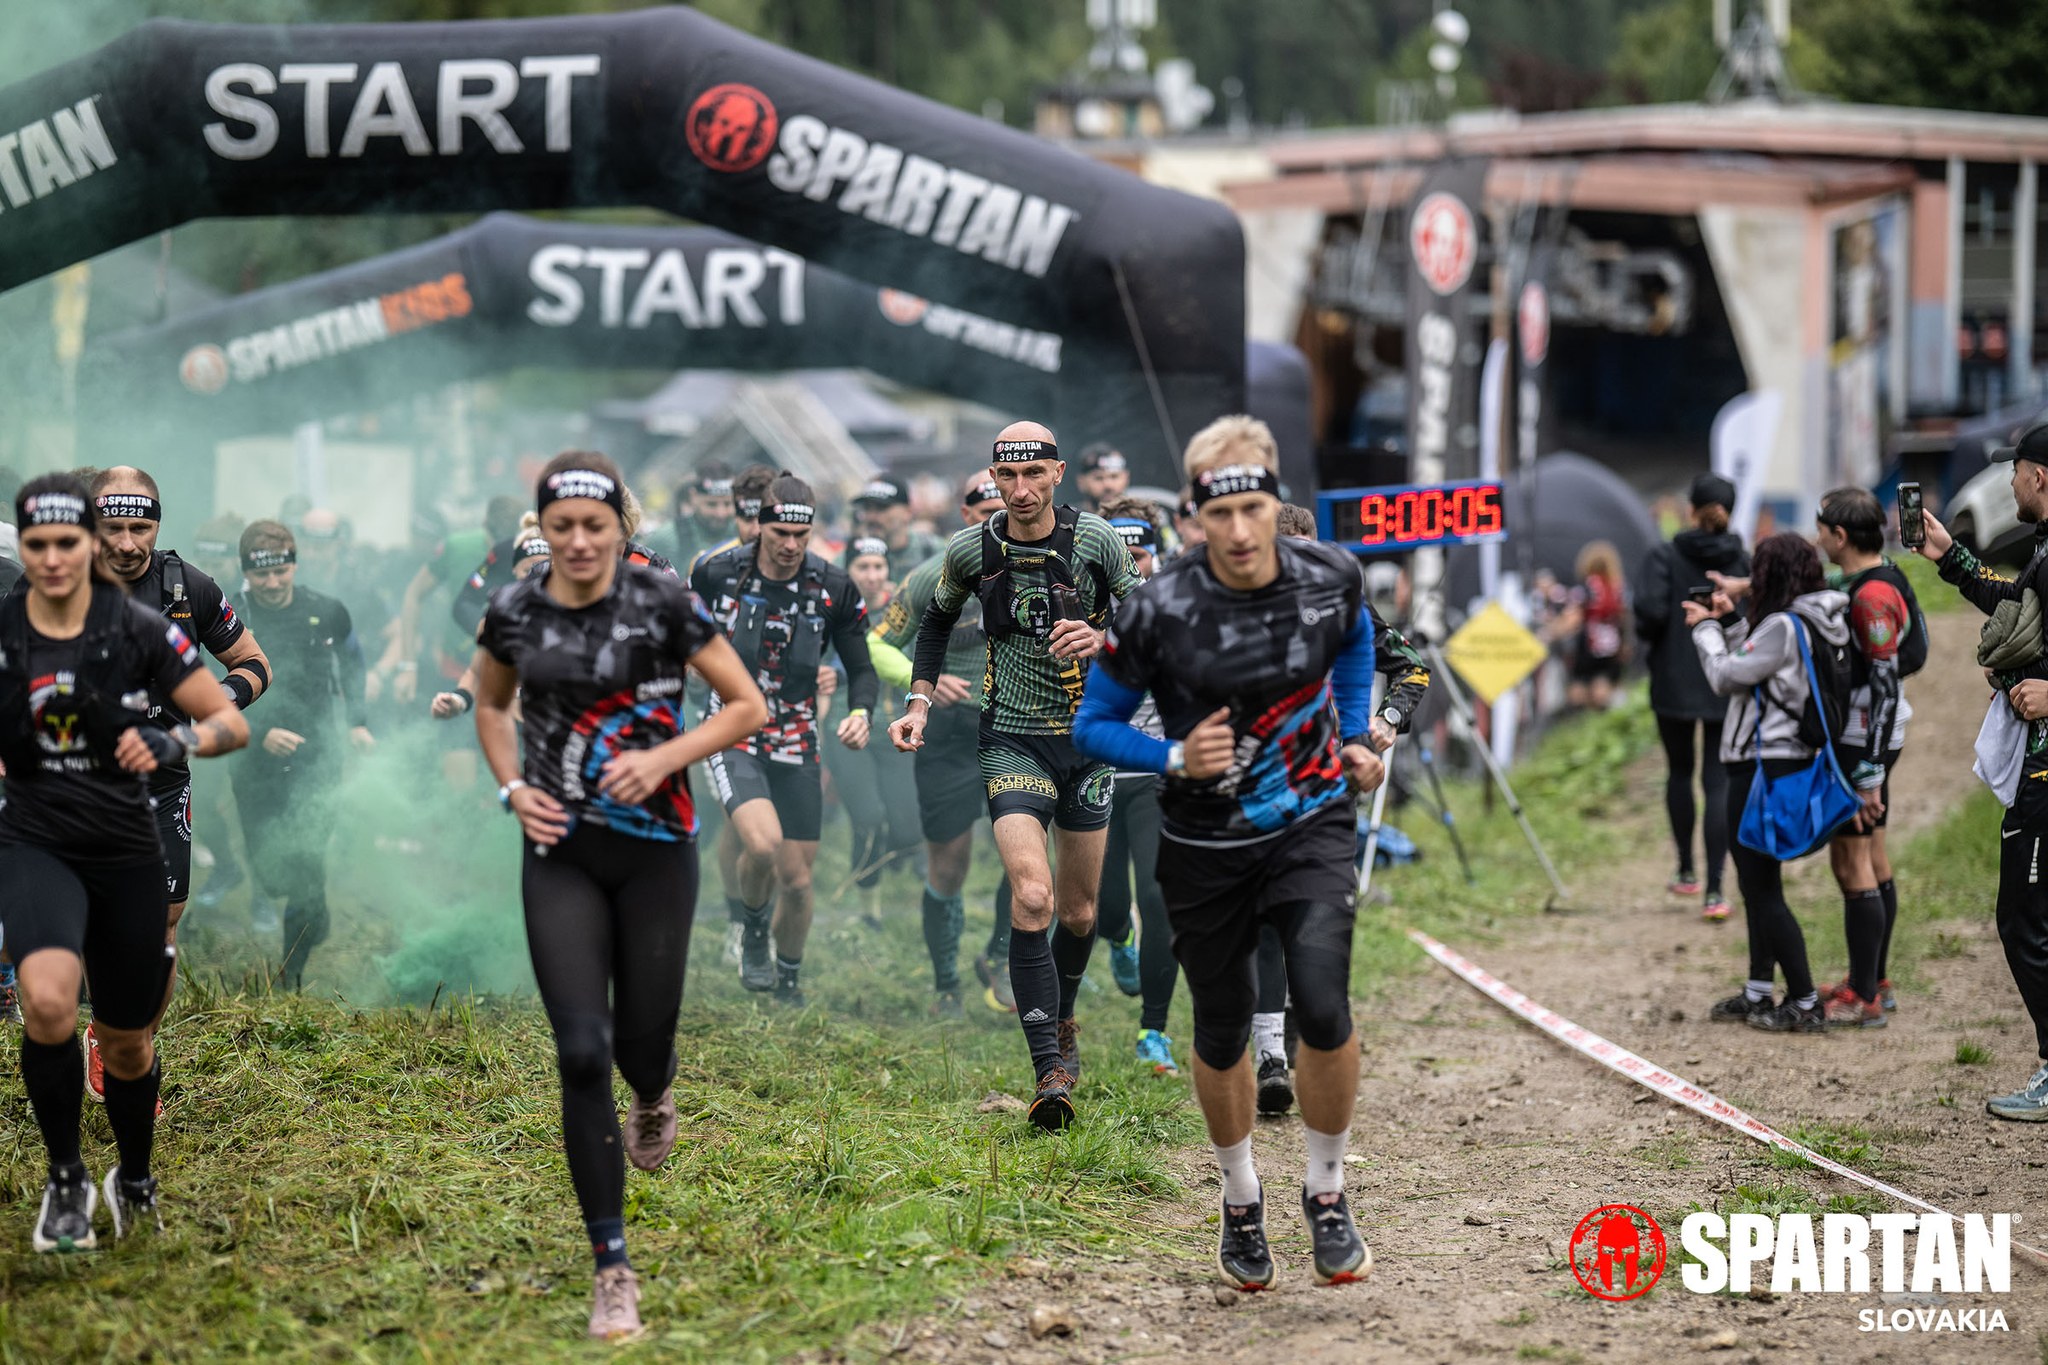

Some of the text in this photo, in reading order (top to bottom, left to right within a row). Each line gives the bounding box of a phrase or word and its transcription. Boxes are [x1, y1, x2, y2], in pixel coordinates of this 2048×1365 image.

[202, 54, 601, 161] START
[0, 97, 118, 212] TAN
[767, 114, 1072, 279] SPARTAN
[526, 244, 806, 329] START
[999, 452, 1035, 461] 30547
[1004, 441, 1042, 452] SPARTAN
[102, 506, 144, 517] 30228
[107, 495, 153, 508] SPARTAN
[1361, 485, 1502, 545] 9:00:05
